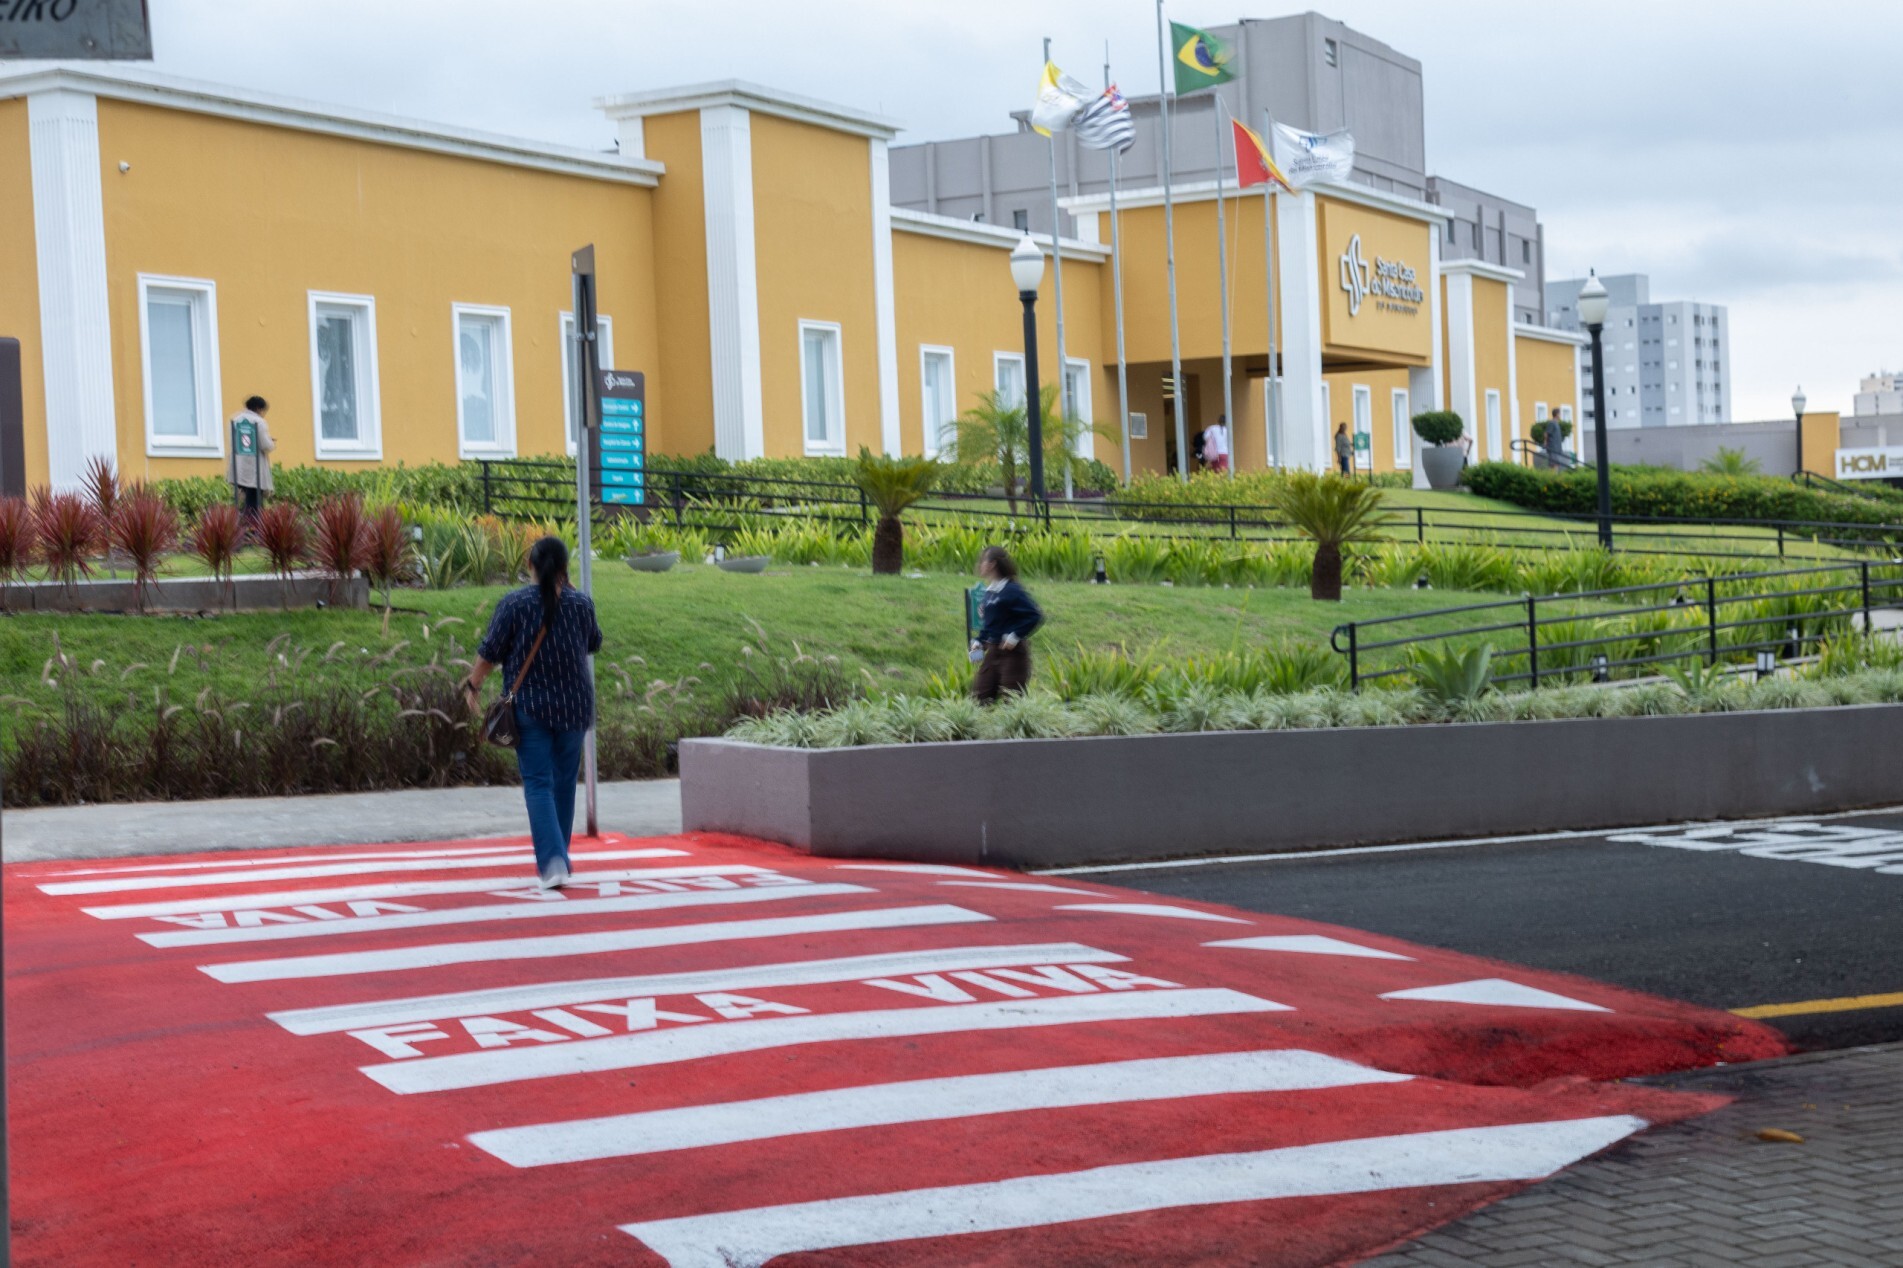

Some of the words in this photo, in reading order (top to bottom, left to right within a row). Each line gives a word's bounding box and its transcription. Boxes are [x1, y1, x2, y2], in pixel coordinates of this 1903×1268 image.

[1841, 455, 1886, 473] HCM
[487, 875, 812, 900] FAIXA
[151, 901, 427, 929] VIVA
[346, 992, 812, 1058] FAIXA
[862, 963, 1187, 1003] VIVA
